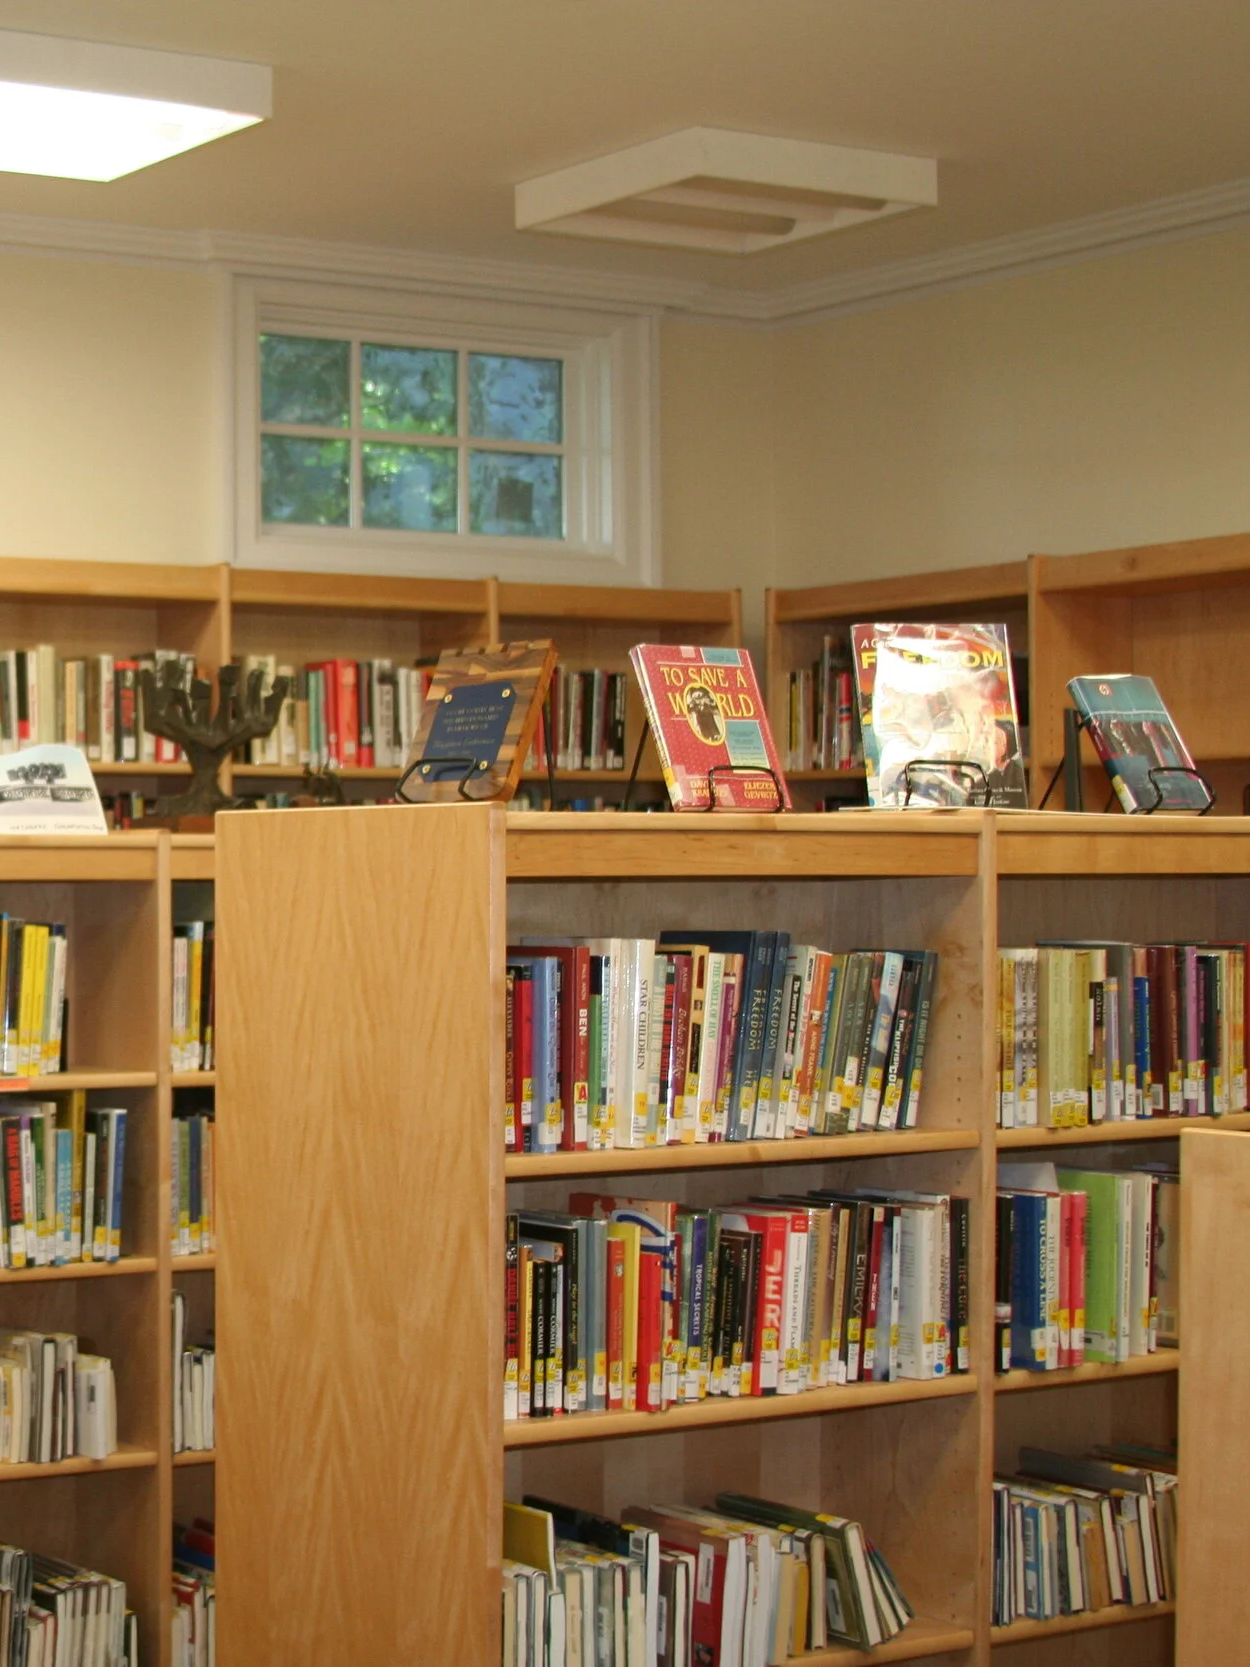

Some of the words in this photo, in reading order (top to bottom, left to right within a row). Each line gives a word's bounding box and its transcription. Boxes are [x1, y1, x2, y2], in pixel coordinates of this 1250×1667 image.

[861, 639, 869, 648] A
[861, 650, 1004, 669] FEEDOM
[660, 666, 684, 687] TO
[688, 666, 729, 688] SAVE
[736, 668, 748, 688] A
[712, 961, 721, 976] THE
[640, 979, 648, 1009] STAR
[710, 977, 720, 1007] SMELL
[790, 993, 798, 1012] Secret
[709, 1009, 718, 1020] OF
[922, 1001, 930, 1009] IS
[579, 1008, 587, 1036] BEN
[676, 1008, 687, 1047] Broken
[707, 1021, 717, 1040] HAY
[748, 989, 761, 1051] FREEDOM
[768, 989, 782, 1049] FREEDOM
[918, 1019, 928, 1043] NIGHT
[637, 1011, 647, 1070] CHILDREN
[809, 1031, 817, 1051] ANNE
[893, 1031, 902, 1066] KLIPFISH
[916, 1045, 924, 1056] OR
[672, 1048, 684, 1080] Bridge
[807, 1052, 815, 1076] FRANK
[915, 1058, 923, 1069] DA
[888, 1066, 898, 1087] COD
[8, 1136, 20, 1157] BAG
[8, 1170, 23, 1220] MARBLES
[1039, 1218, 1047, 1234] TO
[1039, 1236, 1047, 1278] CROSS
[508, 1268, 517, 1306] DANIEL
[793, 1264, 802, 1303] THREADS
[1040, 1279, 1046, 1289] A
[508, 1312, 517, 1337] HALF
[790, 1325, 798, 1349] FLAM
